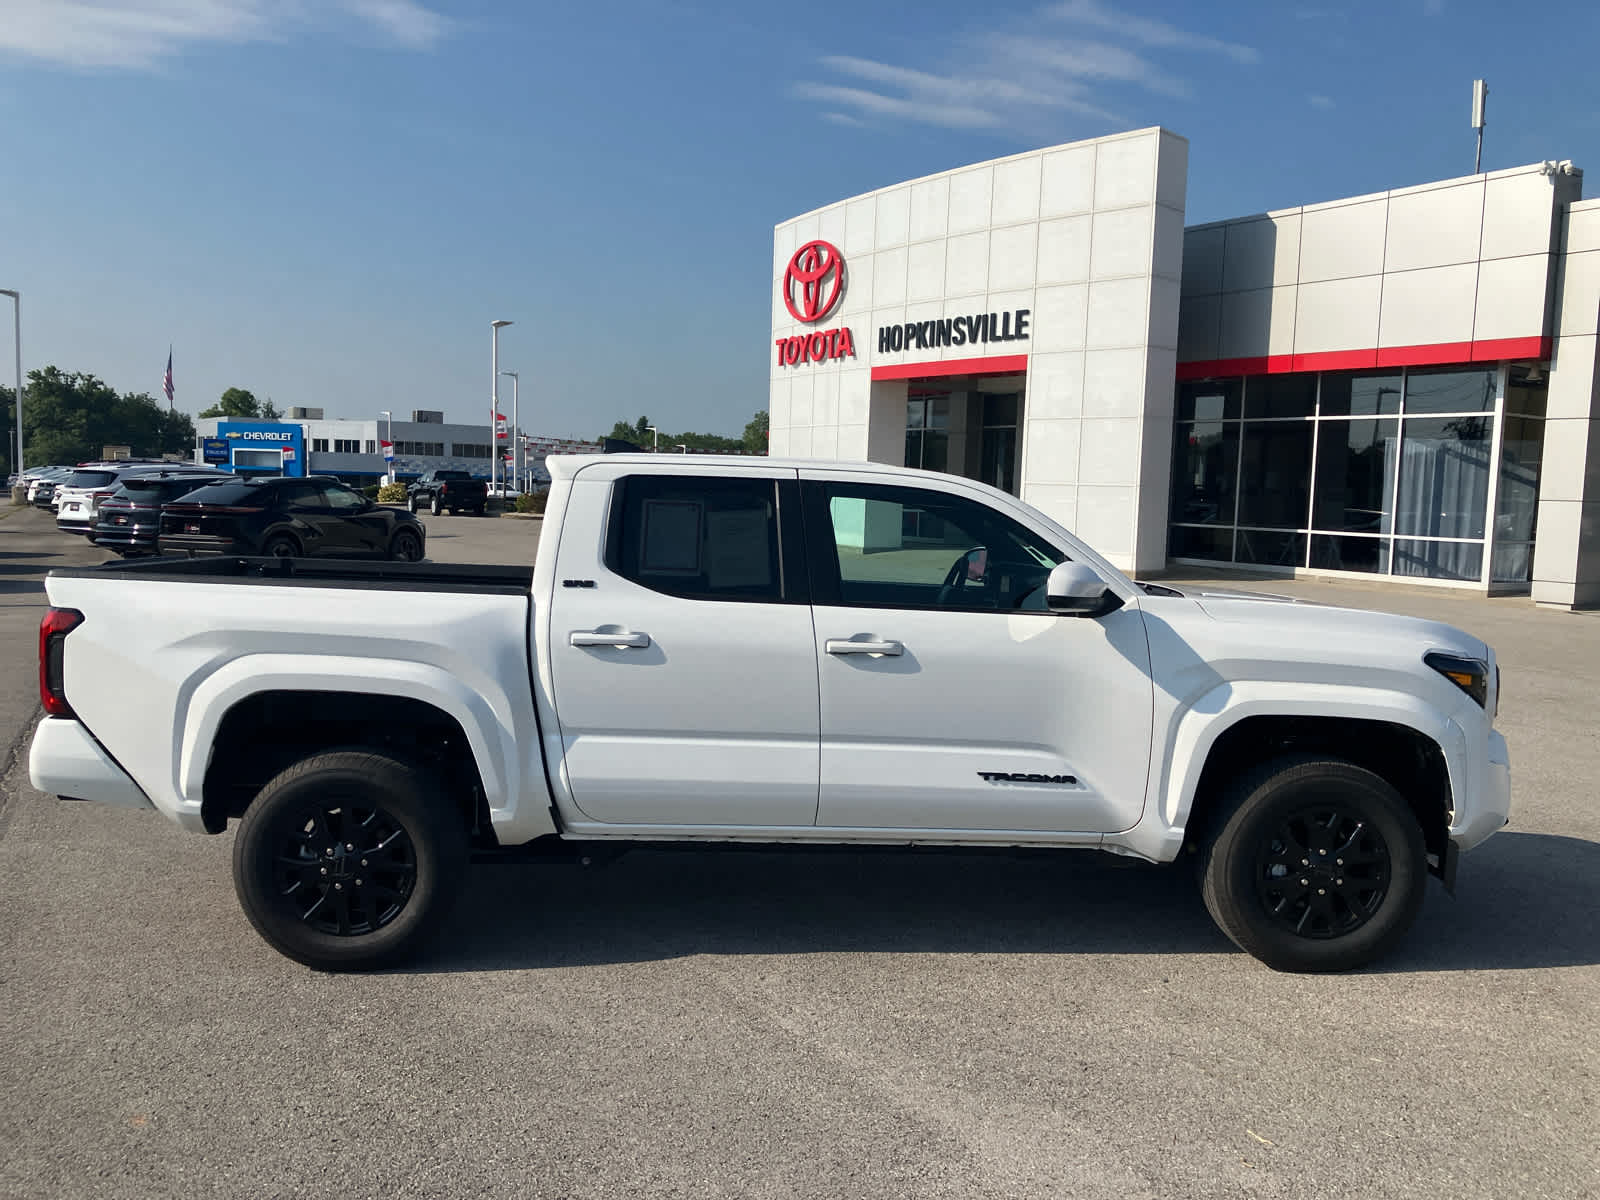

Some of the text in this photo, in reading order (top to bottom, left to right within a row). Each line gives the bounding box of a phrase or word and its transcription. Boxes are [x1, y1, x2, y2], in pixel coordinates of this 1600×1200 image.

[879, 310, 1031, 353] HOPKINSVILLE
[776, 327, 853, 366] TOYOTA
[243, 432, 292, 441] CHEVROLET
[977, 772, 1077, 785] TACOMA
